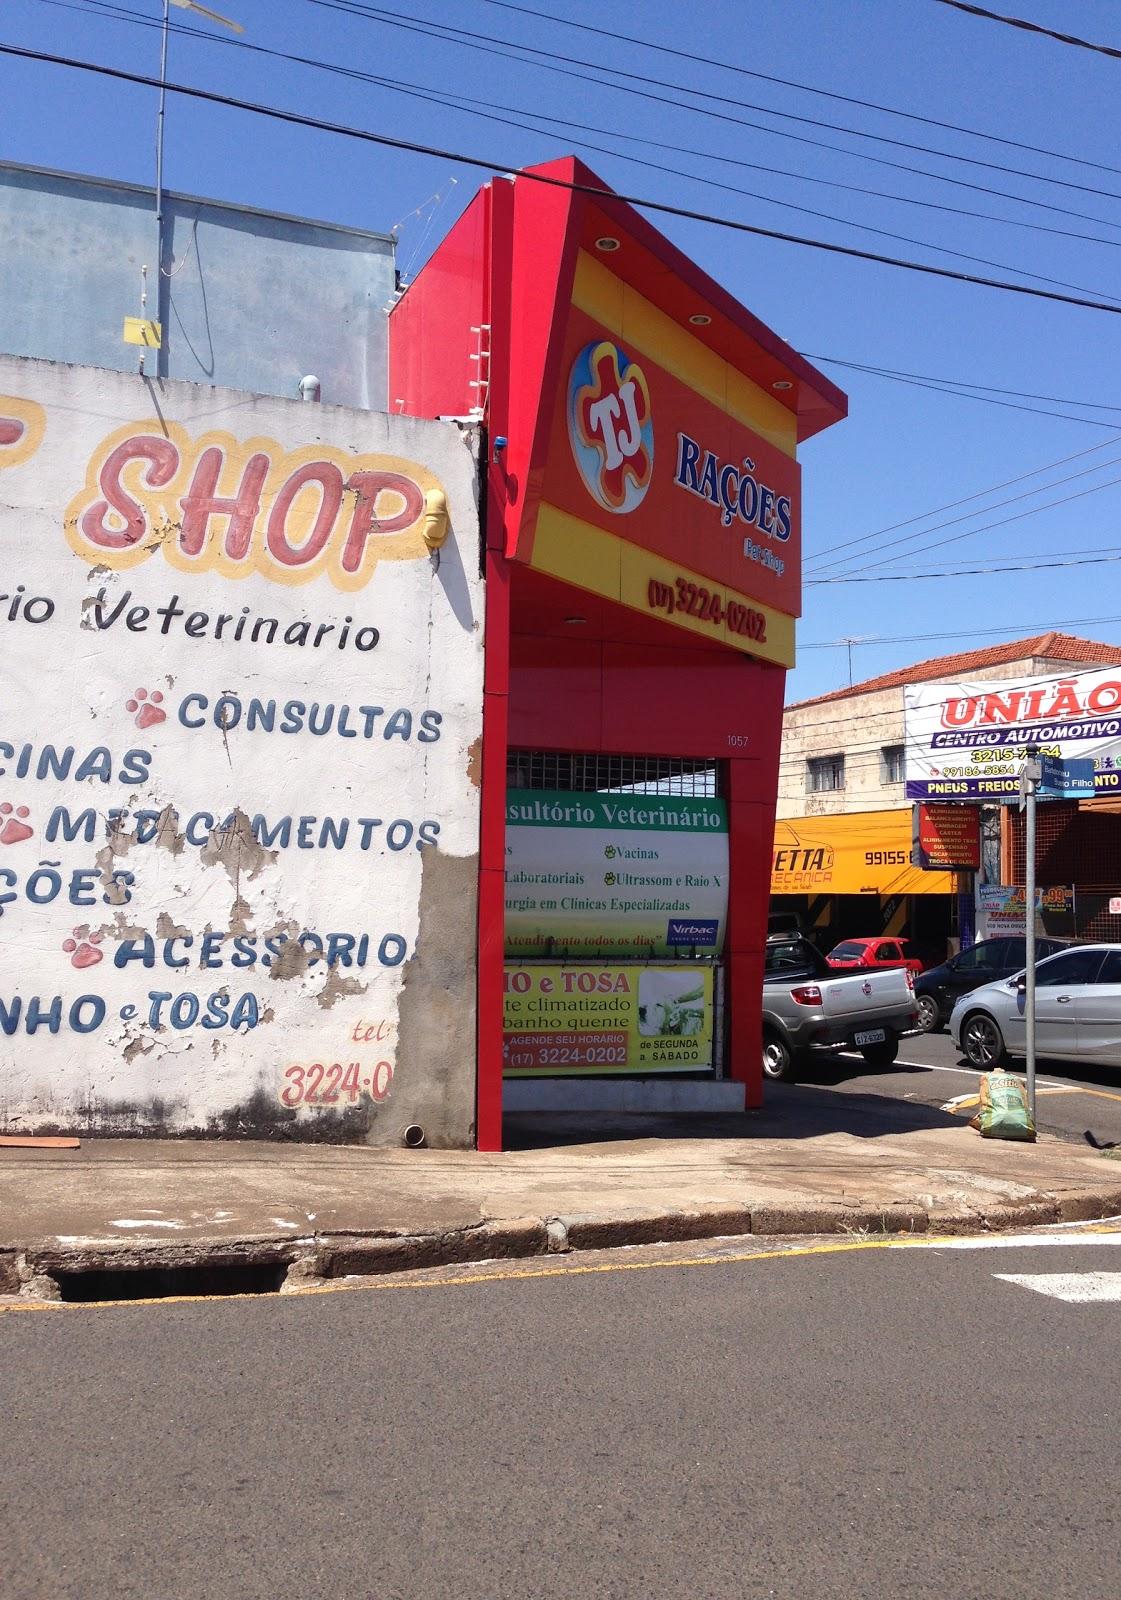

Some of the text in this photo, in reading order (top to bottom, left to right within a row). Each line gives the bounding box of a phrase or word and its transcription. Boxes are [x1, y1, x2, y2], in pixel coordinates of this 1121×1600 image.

[674, 432, 791, 542] RAÇÕES
[82, 435, 425, 573] SHOP
[675, 577, 767, 643] 3224-0202
[940, 680, 1121, 729] UNIÃO
[178, 693, 443, 743] CONSULTAS
[728, 735, 749, 747] 1057
[936, 721, 1120, 747] CENTRO AUTOMOTIVO
[971, 745, 1062, 763] 3215-754
[928, 782, 968, 794] PNEUS
[978, 780, 1021, 793] FREIOS
[1072, 779, 1093, 787] Filho
[601, 803, 721, 827] Veterinário
[616, 847, 659, 859] Vacinas
[504, 870, 585, 885] Laboratoriais
[616, 873, 721, 887] Ultrassom e Raio X
[540, 900, 557, 909] em
[561, 897, 607, 910] Clínicas
[611, 898, 690, 912] Especializadas
[673, 924, 715, 934] Virbac
[584, 935, 614, 946] todos
[617, 938, 630, 946] os
[540, 977, 553, 993] e
[561, 971, 631, 993] TOSA
[120, 1004, 138, 1020] e
[148, 991, 259, 1031] TOSA
[527, 998, 631, 1011] climatizado
[503, 1017, 629, 1031] banho quente
[510, 1033, 624, 1045] AGENDE SEU HORÁRIO
[640, 1040, 698, 1049] de SEGUNDA
[511, 1047, 626, 1066] (17) 3224-0202
